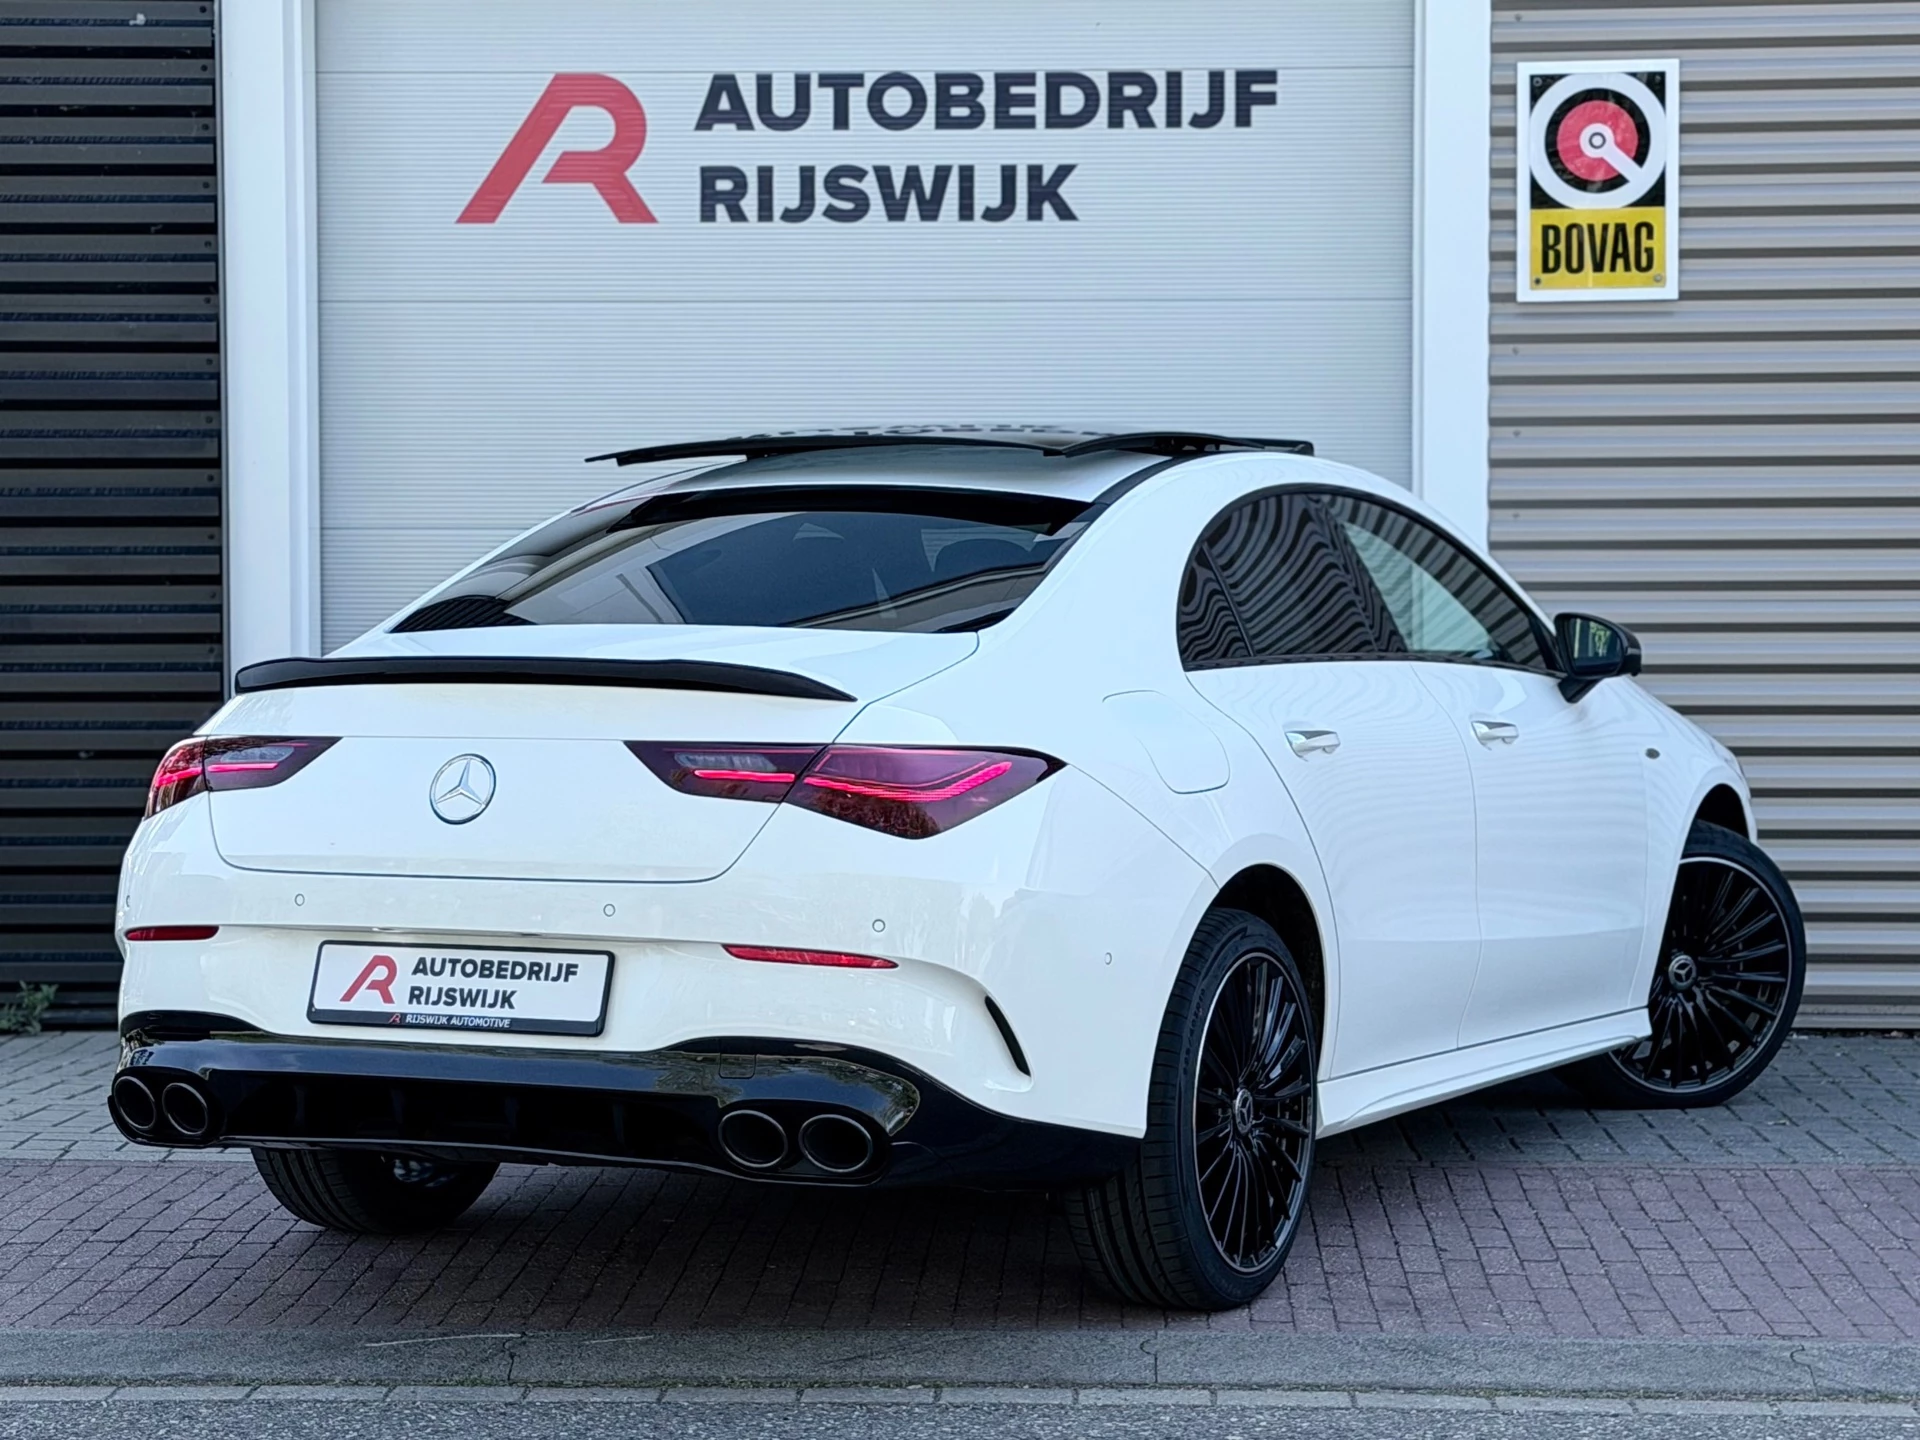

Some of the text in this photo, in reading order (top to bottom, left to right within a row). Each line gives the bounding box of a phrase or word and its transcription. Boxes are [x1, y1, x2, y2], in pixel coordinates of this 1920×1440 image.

[694, 69, 1278, 132] AUTOBEDRIJF
[698, 163, 1079, 223] RIJSWIJK
[1541, 221, 1655, 275] BOVAG
[411, 957, 578, 982] AUTOBEDRIJF
[408, 986, 516, 1009] RIJSWIJK
[405, 1013, 449, 1025] RIJSWIJK
[450, 1016, 512, 1028] AUTOMOTIVE
